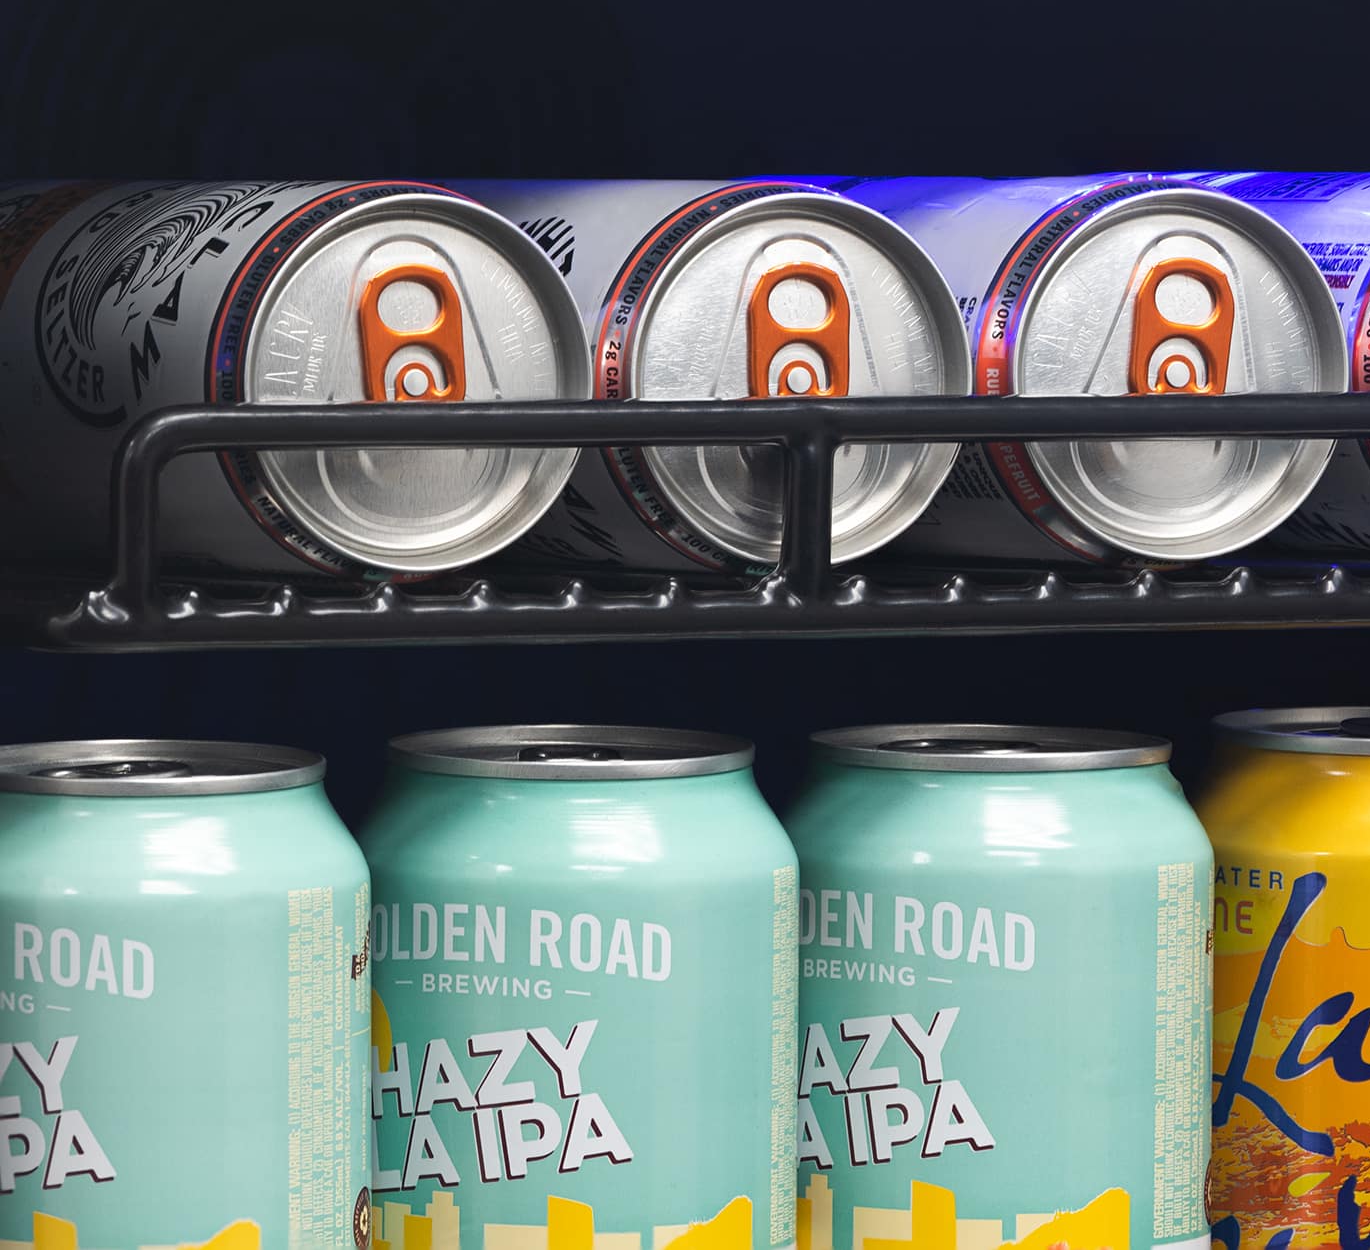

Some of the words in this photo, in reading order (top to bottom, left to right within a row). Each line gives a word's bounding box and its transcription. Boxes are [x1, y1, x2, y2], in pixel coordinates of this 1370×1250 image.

[281, 209, 326, 246] CARBS
[650, 208, 712, 261] NATURAL
[1020, 215, 1074, 271] NATURAL
[241, 254, 277, 313] GLUTEN
[614, 254, 659, 326] FLAVORS
[991, 272, 1026, 340] FLAVORS
[46, 254, 105, 403] SELTZER
[224, 314, 244, 355] FREE
[604, 367, 620, 400] CAR
[617, 447, 648, 495] LUTEN
[1000, 444, 1041, 501] PEFRUIT
[256, 495, 311, 551] NATURAL
[1214, 864, 1285, 892] ATER
[14, 921, 155, 1000] ROAD
[335, 925, 344, 968] WHEAT
[371, 902, 507, 964] OLDEN
[529, 909, 673, 982] ROAD
[894, 895, 1037, 973] ROAD
[335, 970, 344, 1030] CONTAINS
[421, 972, 553, 1000] BREWING
[802, 960, 918, 987] BREWING
[371, 1018, 599, 1119] HAZY
[798, 1006, 961, 1097] AZY
[470, 1088, 634, 1185] IPA
[797, 1097, 834, 1170] A
[843, 1080, 997, 1168] IPA
[1154, 1099, 1165, 1159] WARNING:
[1153, 1162, 1164, 1239] GOVERNMENT
